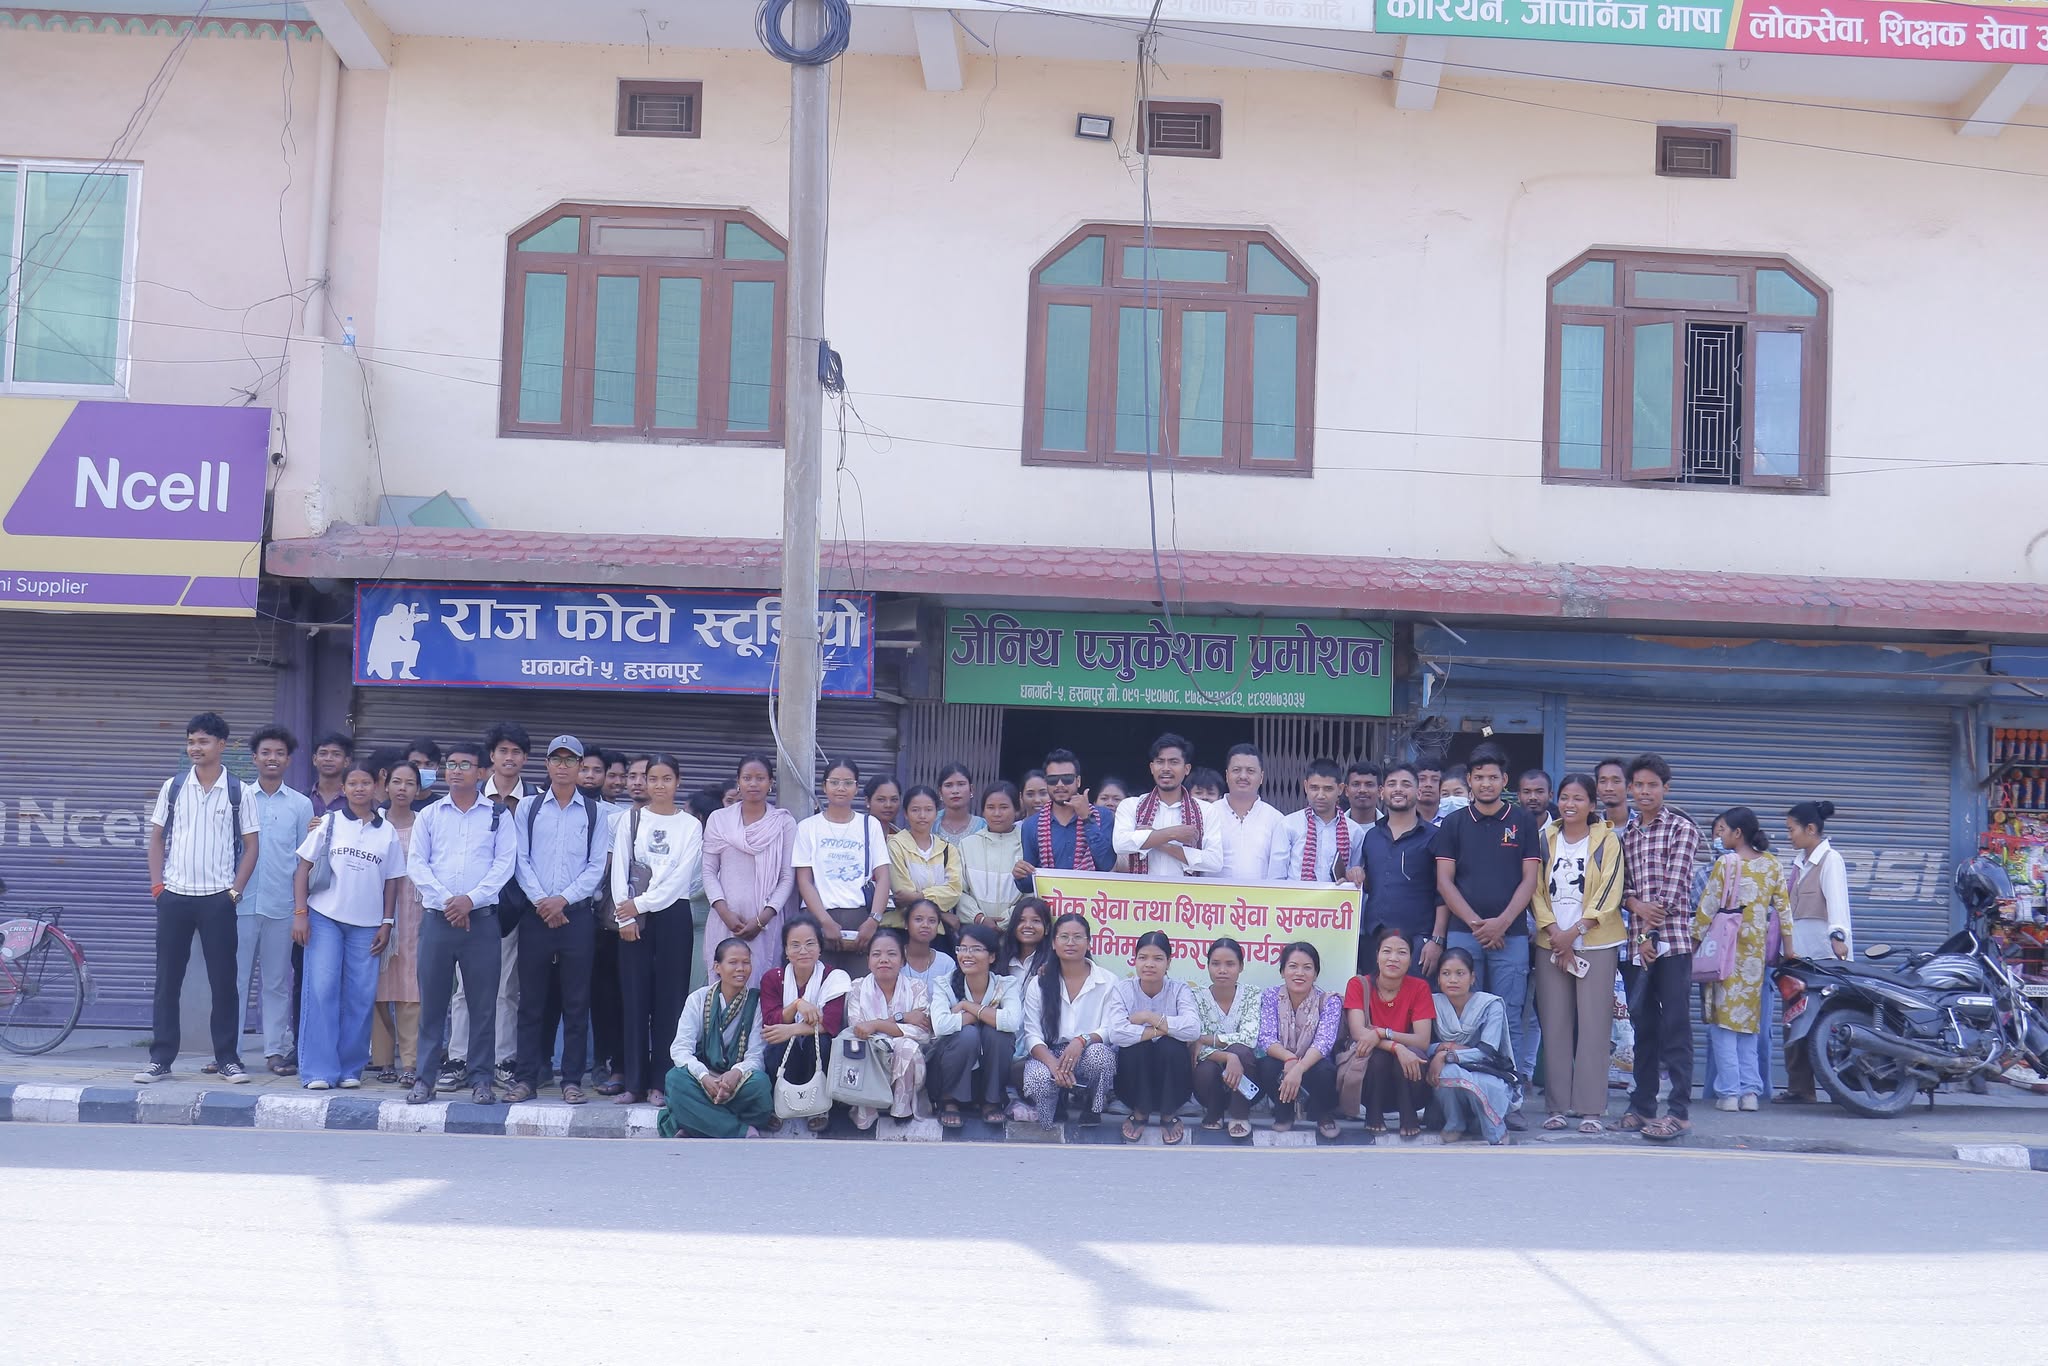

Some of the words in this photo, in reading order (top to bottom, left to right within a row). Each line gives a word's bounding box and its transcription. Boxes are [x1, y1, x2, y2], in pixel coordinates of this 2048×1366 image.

[1658, 4, 1722, 34] भाषा
[1749, 6, 1869, 45] लोकसेवा,
[1879, 10, 1968, 49] शिक्षक
[1975, 16, 2028, 50] सेवा
[74, 456, 230, 512] Ncell
[16, 577, 89, 596] Supplier
[440, 597, 542, 641] राज
[555, 593, 675, 644] फोटो
[950, 613, 1064, 668] जेनिथ
[1074, 619, 1238, 682] एजुकेशन
[1248, 623, 1385, 680] प्रमोशन
[623, 662, 704, 685] हसनपुर
[1069, 686, 1105, 706] हसनपुर
[1091, 891, 1130, 925] सेवा
[1133, 900, 1172, 922] तथा
[1175, 895, 1227, 931] शिक्षा
[1230, 897, 1269, 931] सेवा
[1276, 902, 1354, 933] सम्बन्धी
